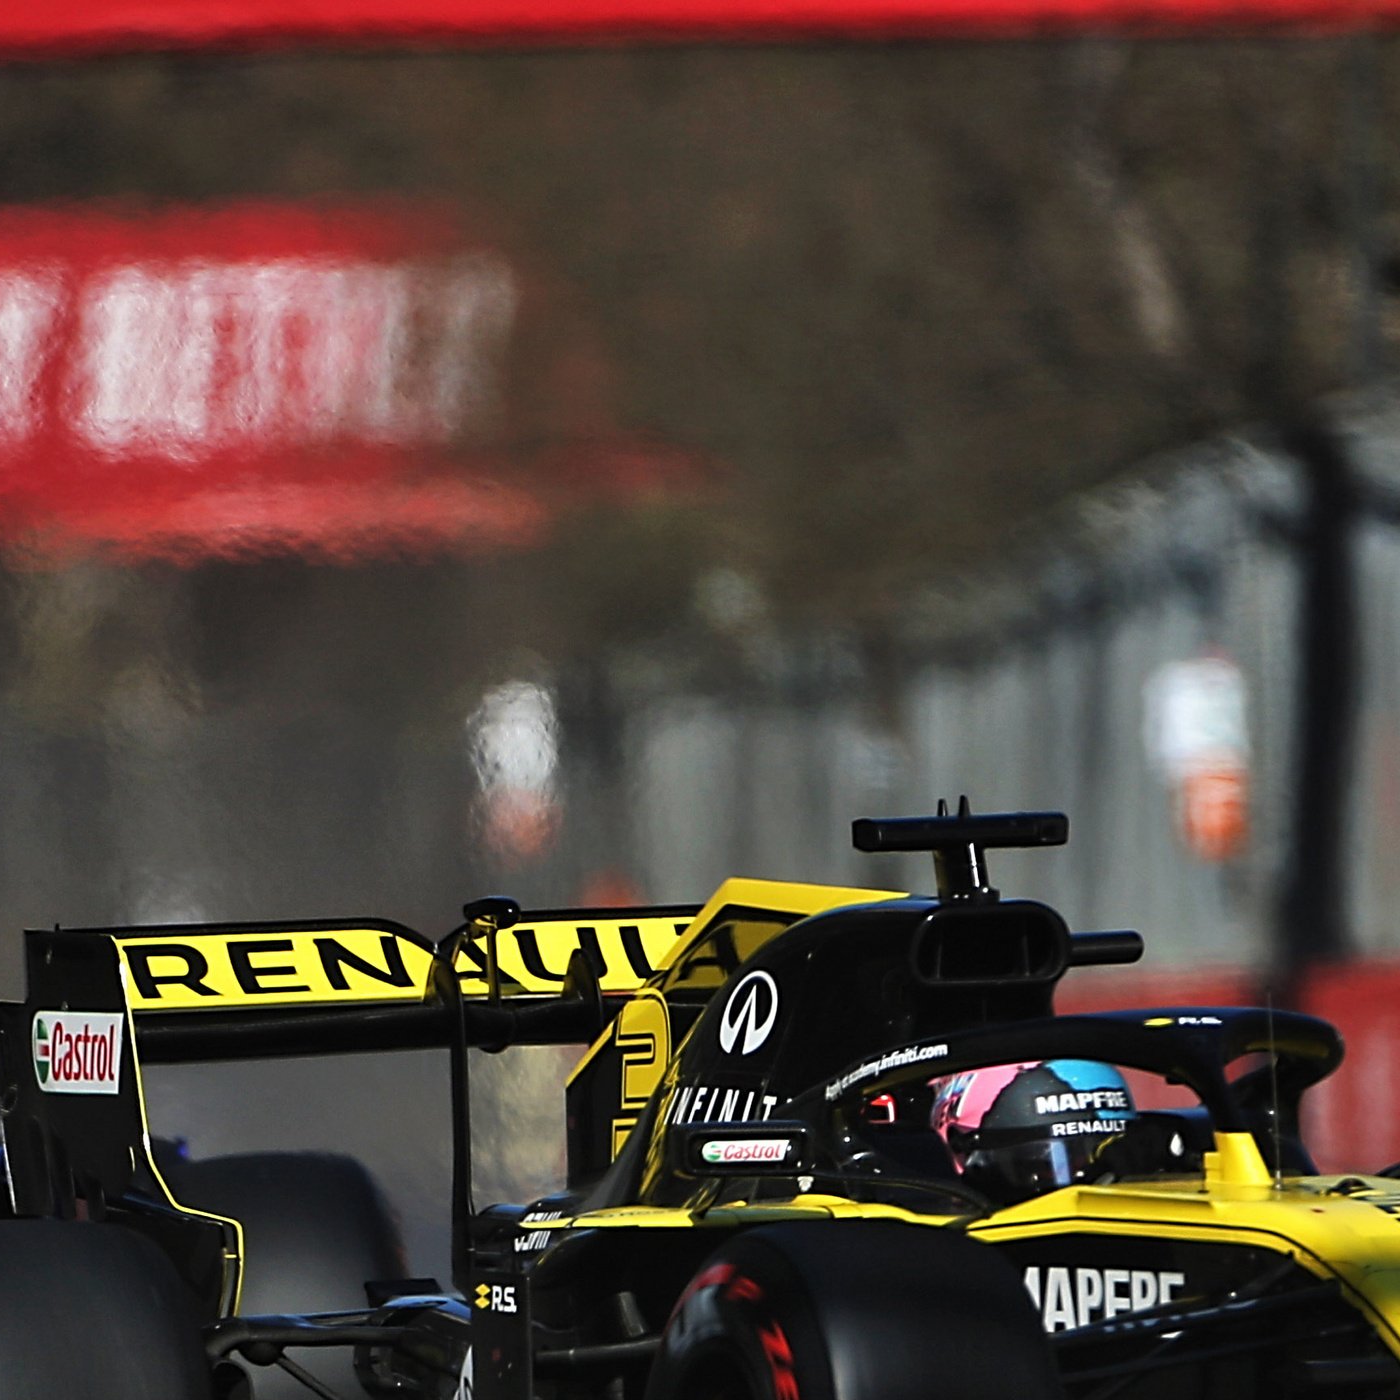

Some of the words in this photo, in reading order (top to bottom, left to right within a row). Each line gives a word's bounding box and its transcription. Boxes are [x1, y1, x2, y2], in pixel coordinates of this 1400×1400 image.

[125, 922, 694, 1000] RENAUL
[51, 1021, 115, 1081] Castrol
[664, 1087, 792, 1125] INFINIT
[1035, 1091, 1128, 1115] MAPFRE
[1052, 1119, 1127, 1137] RENAULT
[723, 1142, 781, 1160] Castrol
